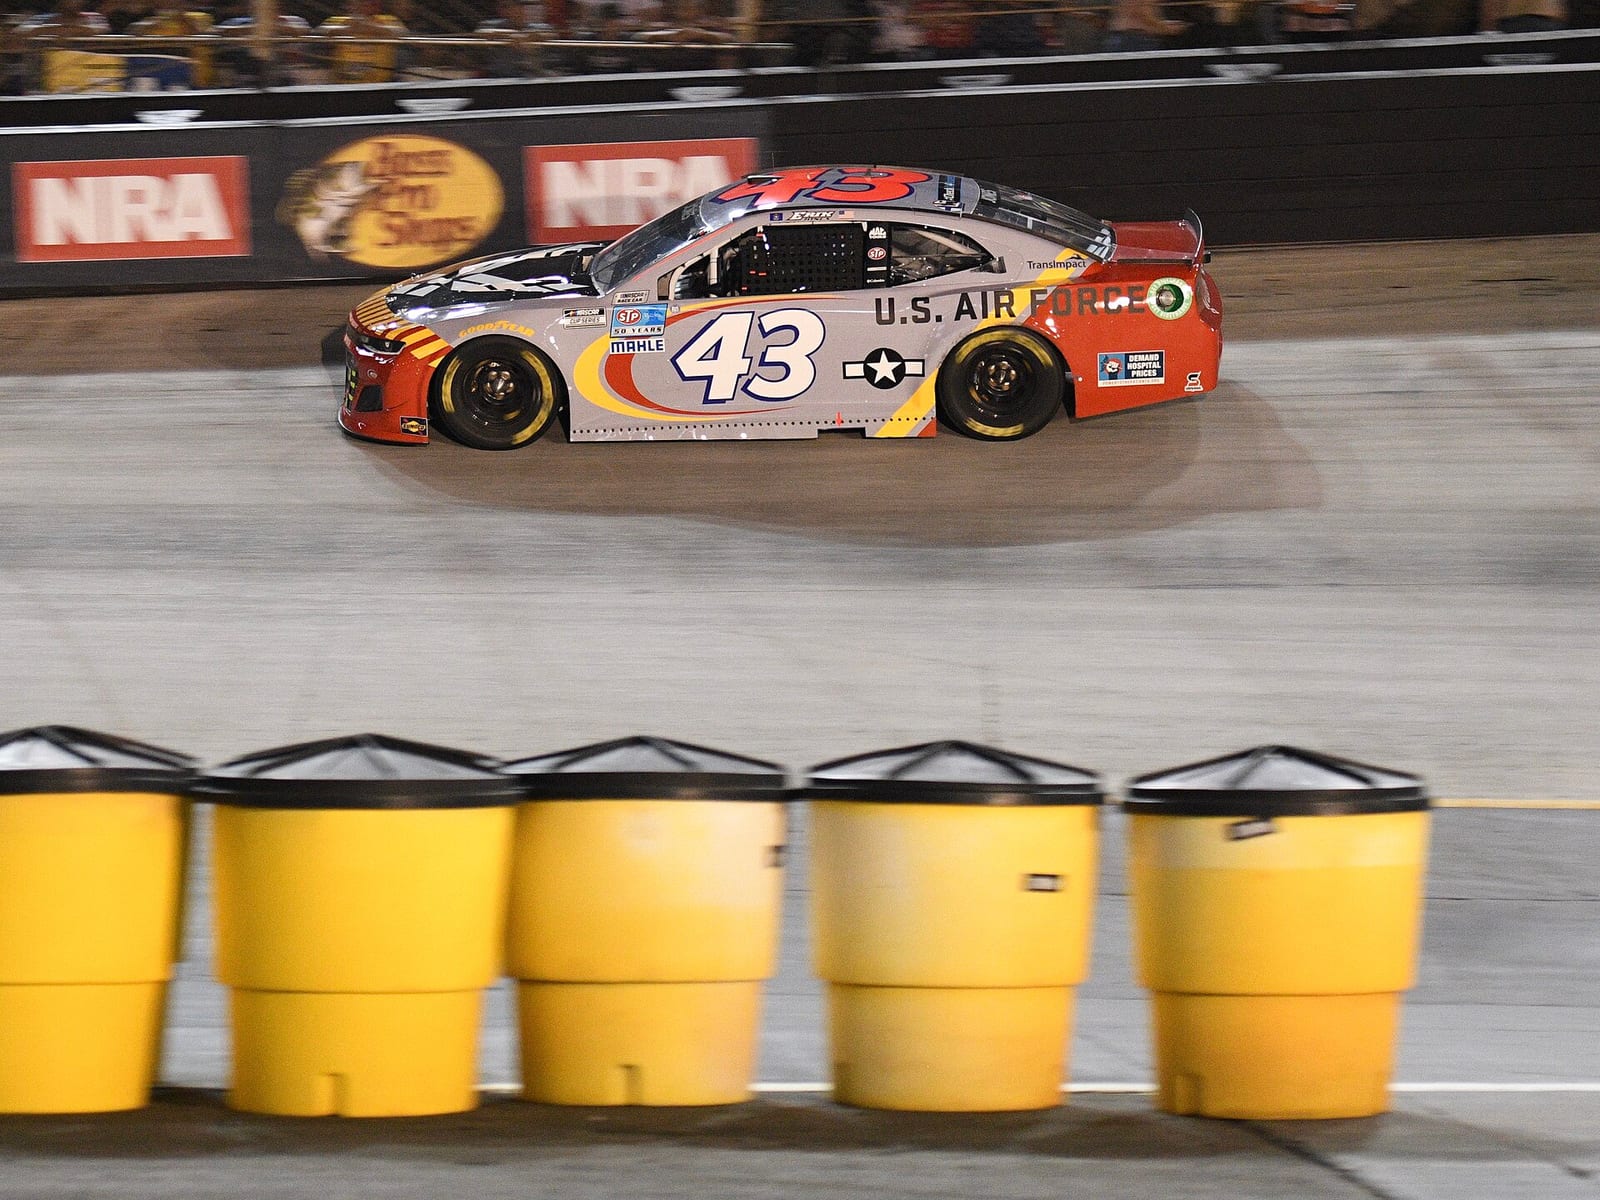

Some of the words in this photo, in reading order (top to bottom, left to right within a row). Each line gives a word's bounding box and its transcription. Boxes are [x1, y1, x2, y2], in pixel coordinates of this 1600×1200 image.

[540, 155, 733, 228] NRA
[710, 167, 933, 208] 43
[30, 173, 234, 246] NRA
[1026, 260, 1086, 270] TransImpact
[875, 296, 942, 326] U.S.
[954, 290, 1016, 321] AIR
[1030, 285, 1146, 317] FORCE
[619, 309, 639, 323] STP
[458, 320, 535, 338] GOODYEAR
[611, 340, 664, 353] MAHLE
[670, 307, 826, 404] 43
[1128, 353, 1160, 362] DEMAND
[1127, 362, 1161, 370] HOSPITAL
[1131, 369, 1157, 378] PRICES
